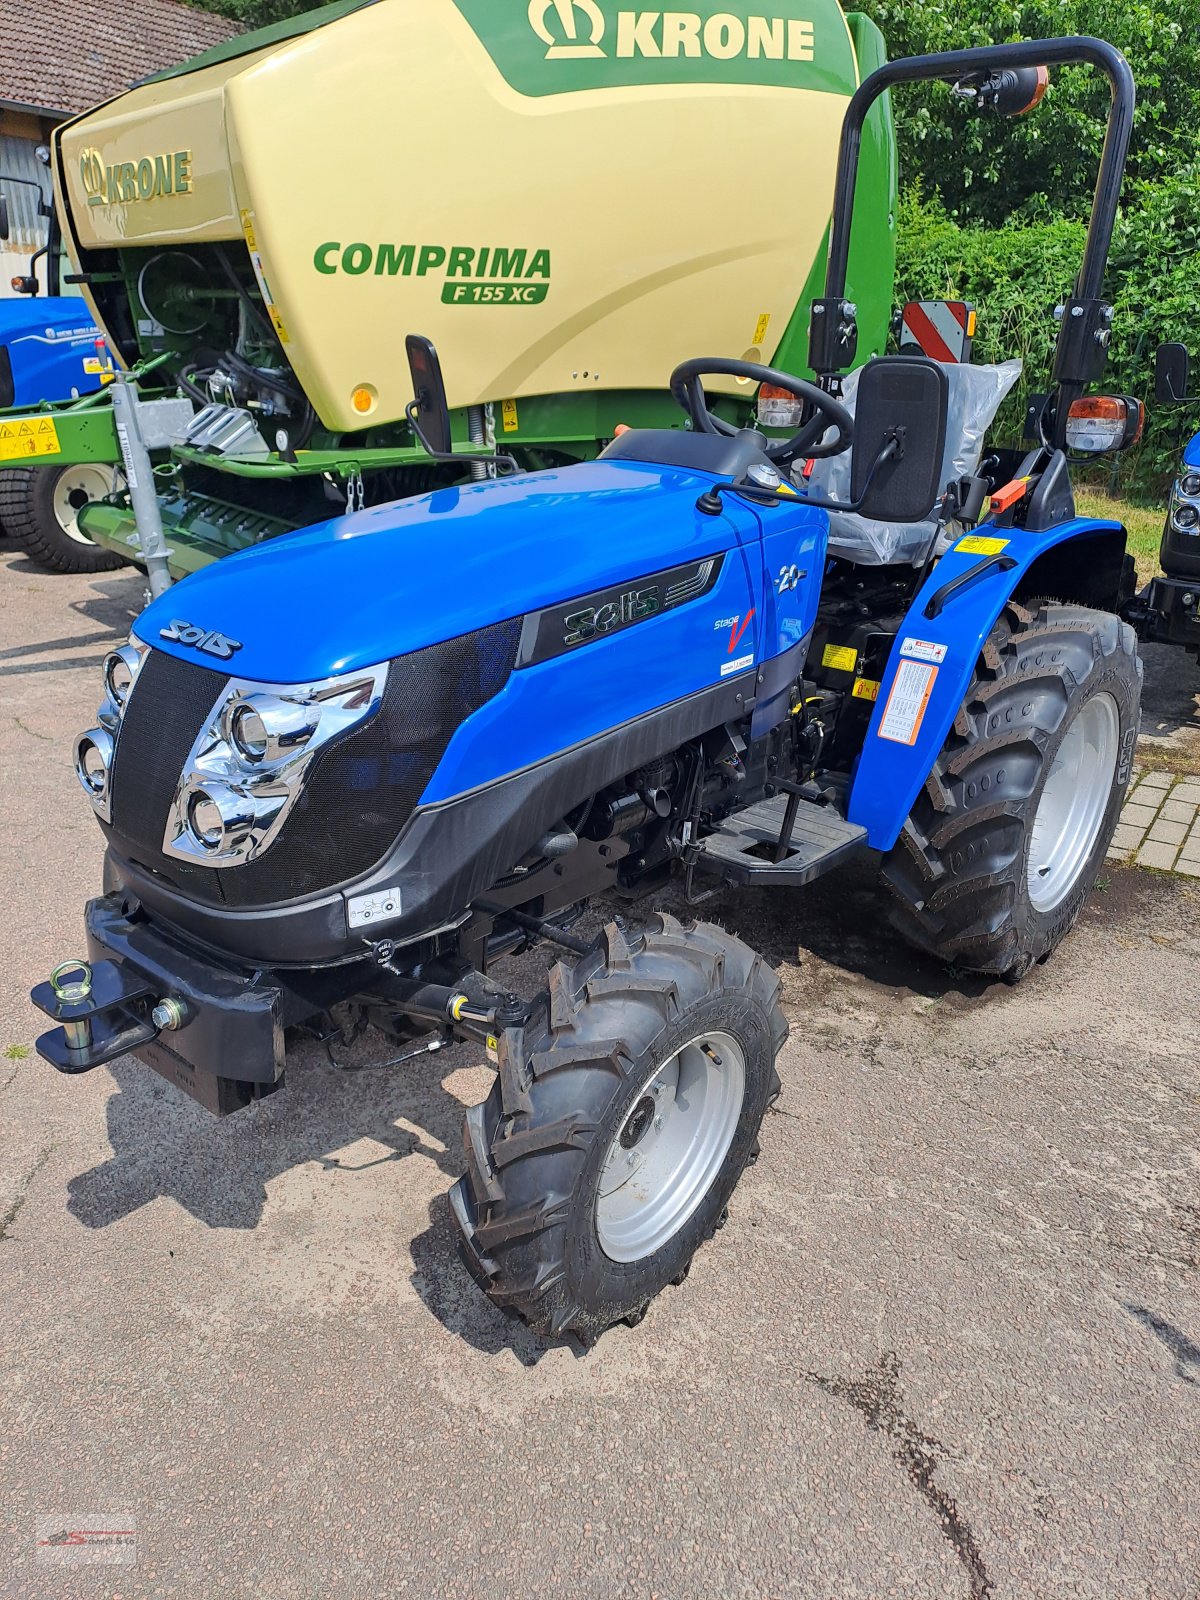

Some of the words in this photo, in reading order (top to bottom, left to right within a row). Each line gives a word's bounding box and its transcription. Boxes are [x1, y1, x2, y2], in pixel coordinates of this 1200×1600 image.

[616, 12, 814, 61] KRONE
[106, 151, 191, 204] KRONE
[314, 242, 550, 278] COMPRIMA
[453, 286, 466, 301] F
[472, 286, 504, 301] 155
[508, 287, 536, 301] XC
[778, 564, 799, 594] 20
[714, 615, 740, 630] Stage
[727, 607, 756, 655] V
